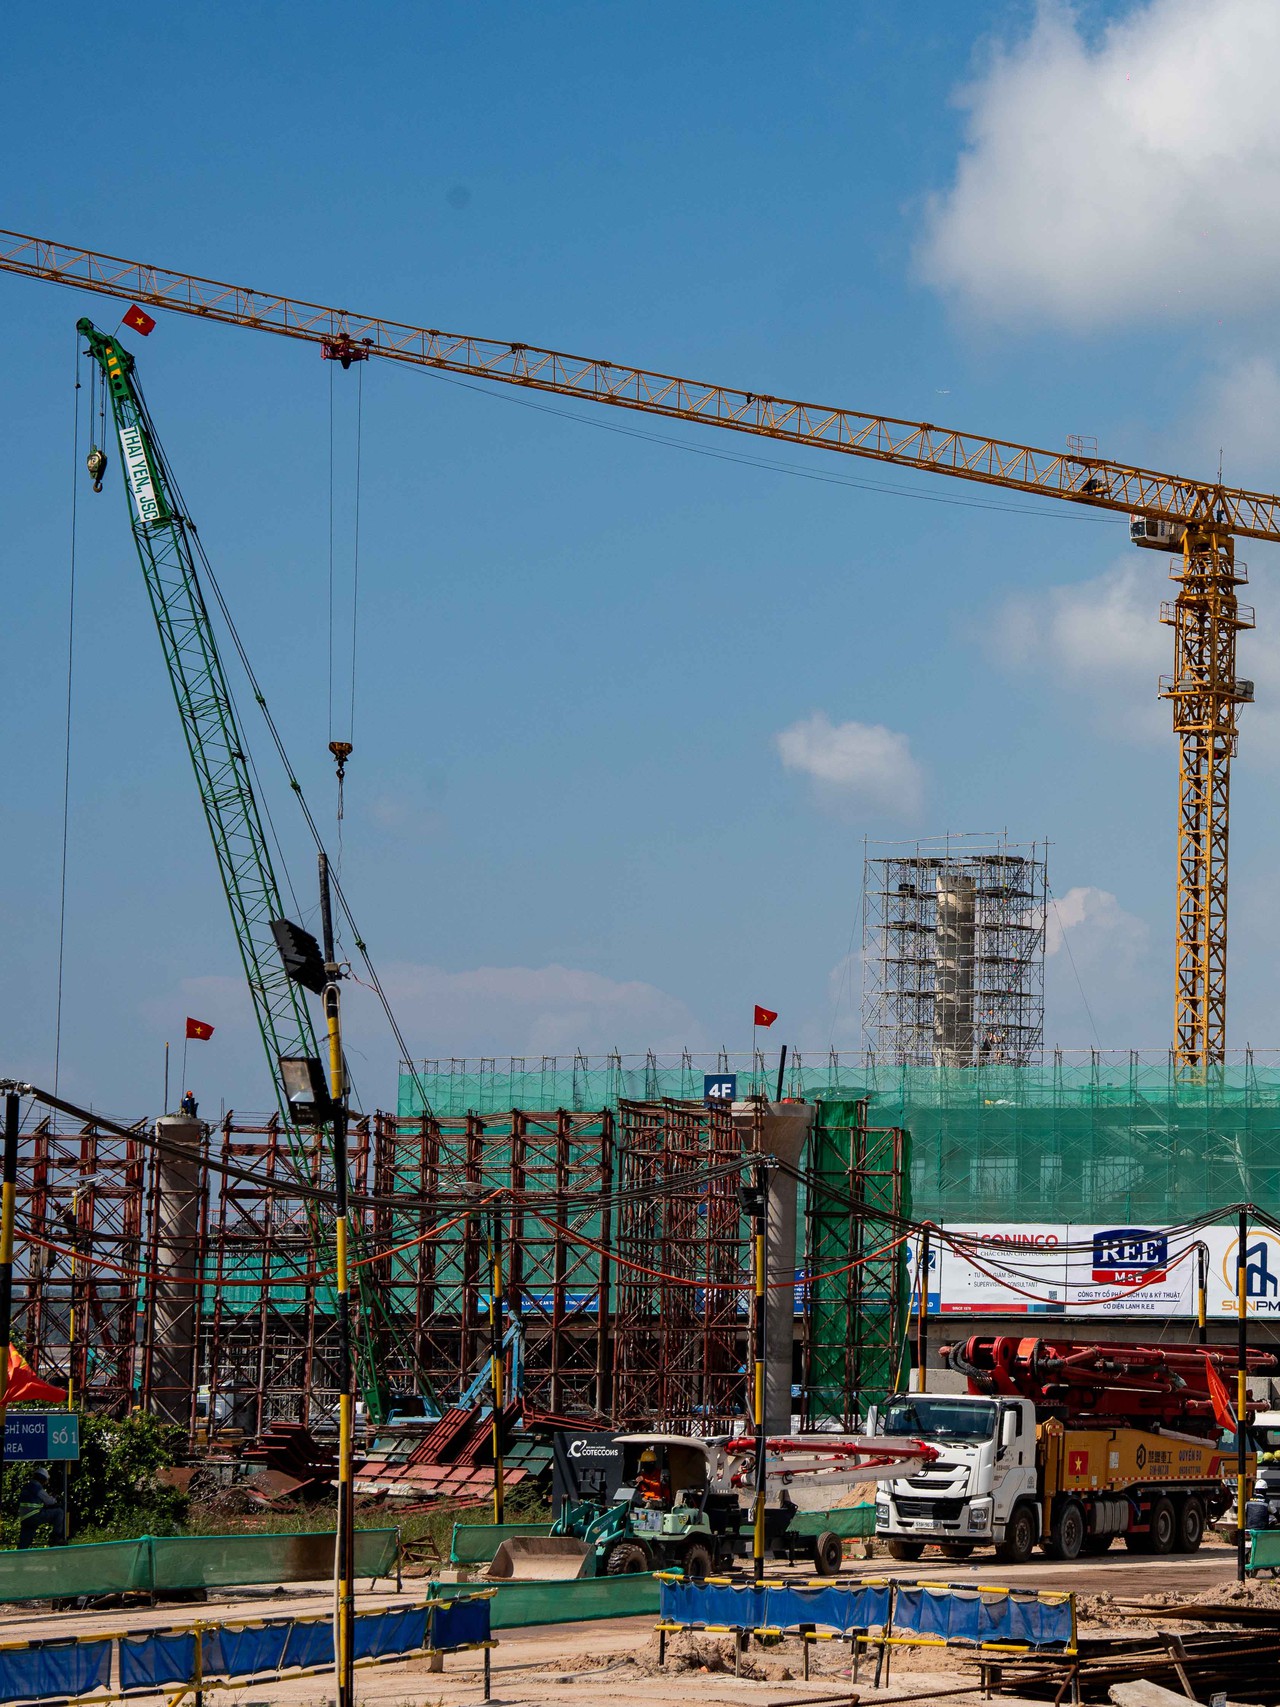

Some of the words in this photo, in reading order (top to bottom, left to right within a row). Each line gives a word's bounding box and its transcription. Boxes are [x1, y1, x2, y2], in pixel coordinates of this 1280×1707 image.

[123, 426, 143, 459] THAI
[140, 496, 158, 520] JSC
[709, 1083, 732, 1098] 4F
[1100, 1239, 1159, 1263] REE
[4, 1421, 20, 1434] GHỈ
[52, 1426, 69, 1444] SỐ
[71, 1431, 77, 1444] 1
